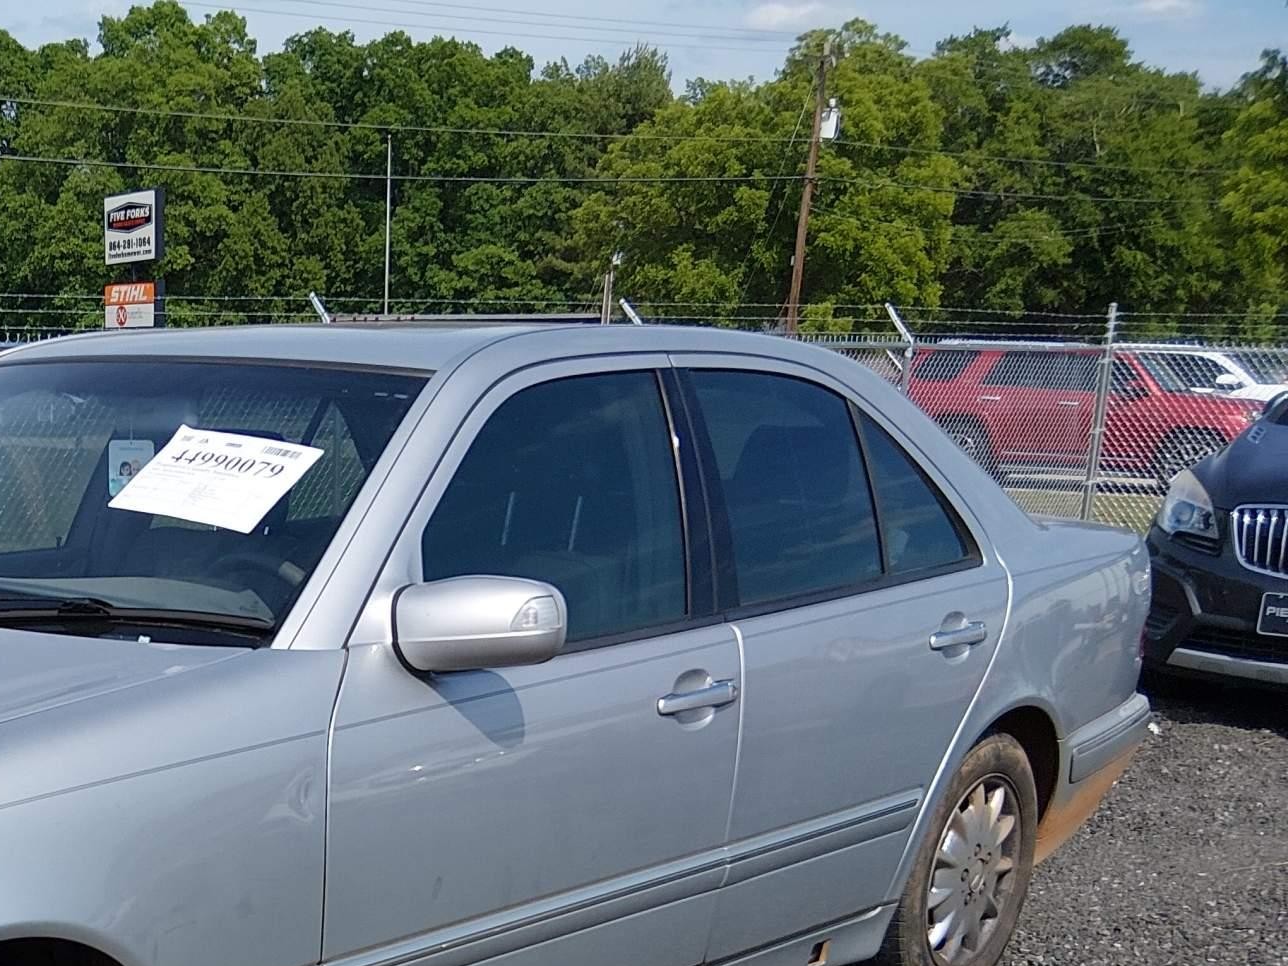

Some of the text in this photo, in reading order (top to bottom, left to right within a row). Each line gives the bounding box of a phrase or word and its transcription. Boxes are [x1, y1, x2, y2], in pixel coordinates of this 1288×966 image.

[109, 206, 149, 223] FIVE FORKS
[111, 285, 147, 303] STIHL
[171, 449, 285, 478] 44990079
